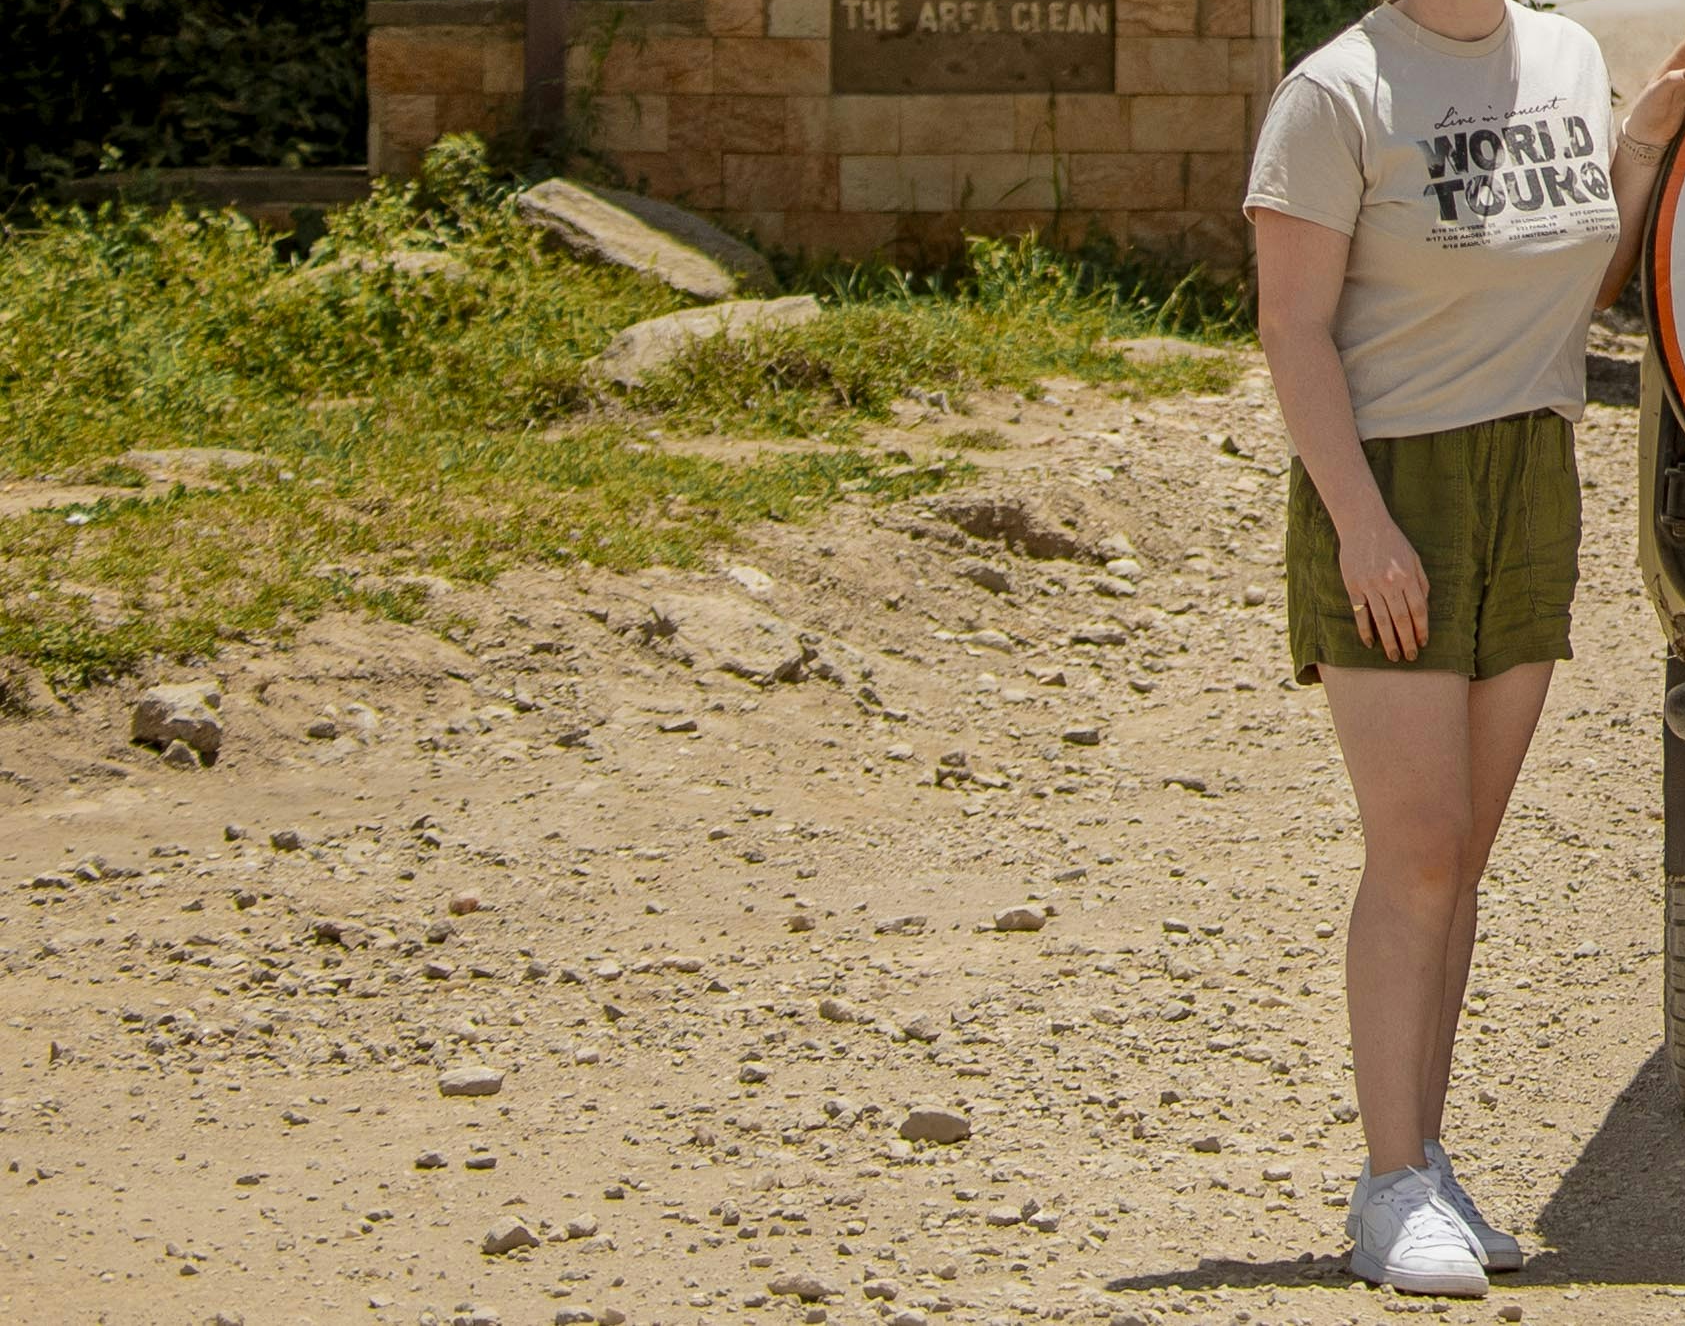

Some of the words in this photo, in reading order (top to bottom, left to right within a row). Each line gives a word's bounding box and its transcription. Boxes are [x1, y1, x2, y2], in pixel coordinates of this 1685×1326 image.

[840, 0, 900, 32] THE
[918, 0, 1000, 33] AREA
[1010, 1, 1109, 34] CLEAN
[1433, 106, 1477, 130] Live
[1481, 105, 1499, 122] in
[1503, 95, 1567, 120] concert
[1416, 115, 1595, 180] WORLD
